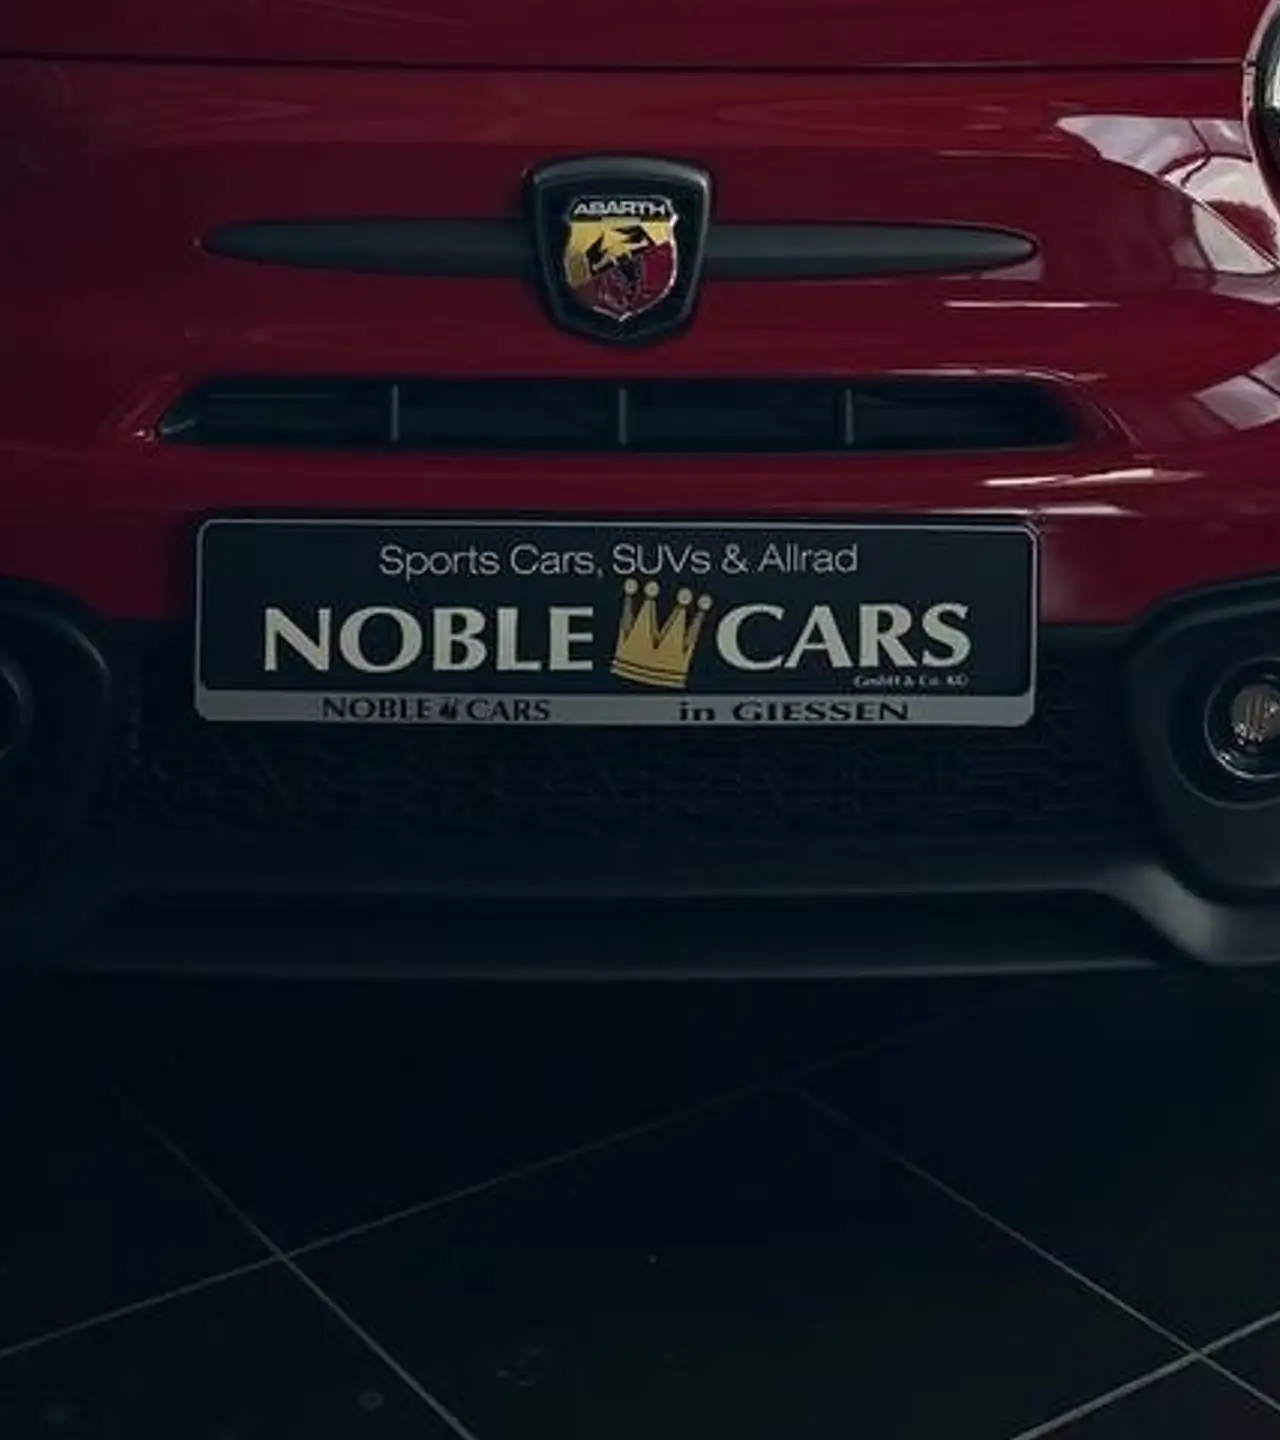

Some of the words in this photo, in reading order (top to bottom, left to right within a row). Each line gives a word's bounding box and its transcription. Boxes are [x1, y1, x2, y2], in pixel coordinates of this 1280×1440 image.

[574, 201, 666, 215] ABARTH
[379, 545, 501, 581] Sports
[510, 545, 603, 578] Cars,
[612, 543, 711, 574] SUVs
[721, 544, 750, 574] &
[757, 543, 859, 573] Allrad
[263, 605, 594, 673] NOBLE
[716, 603, 972, 671] CARS
[322, 697, 430, 720] NOBLE
[466, 699, 551, 721] CARS
[679, 702, 715, 722] in
[733, 701, 909, 722] GIESSEN
